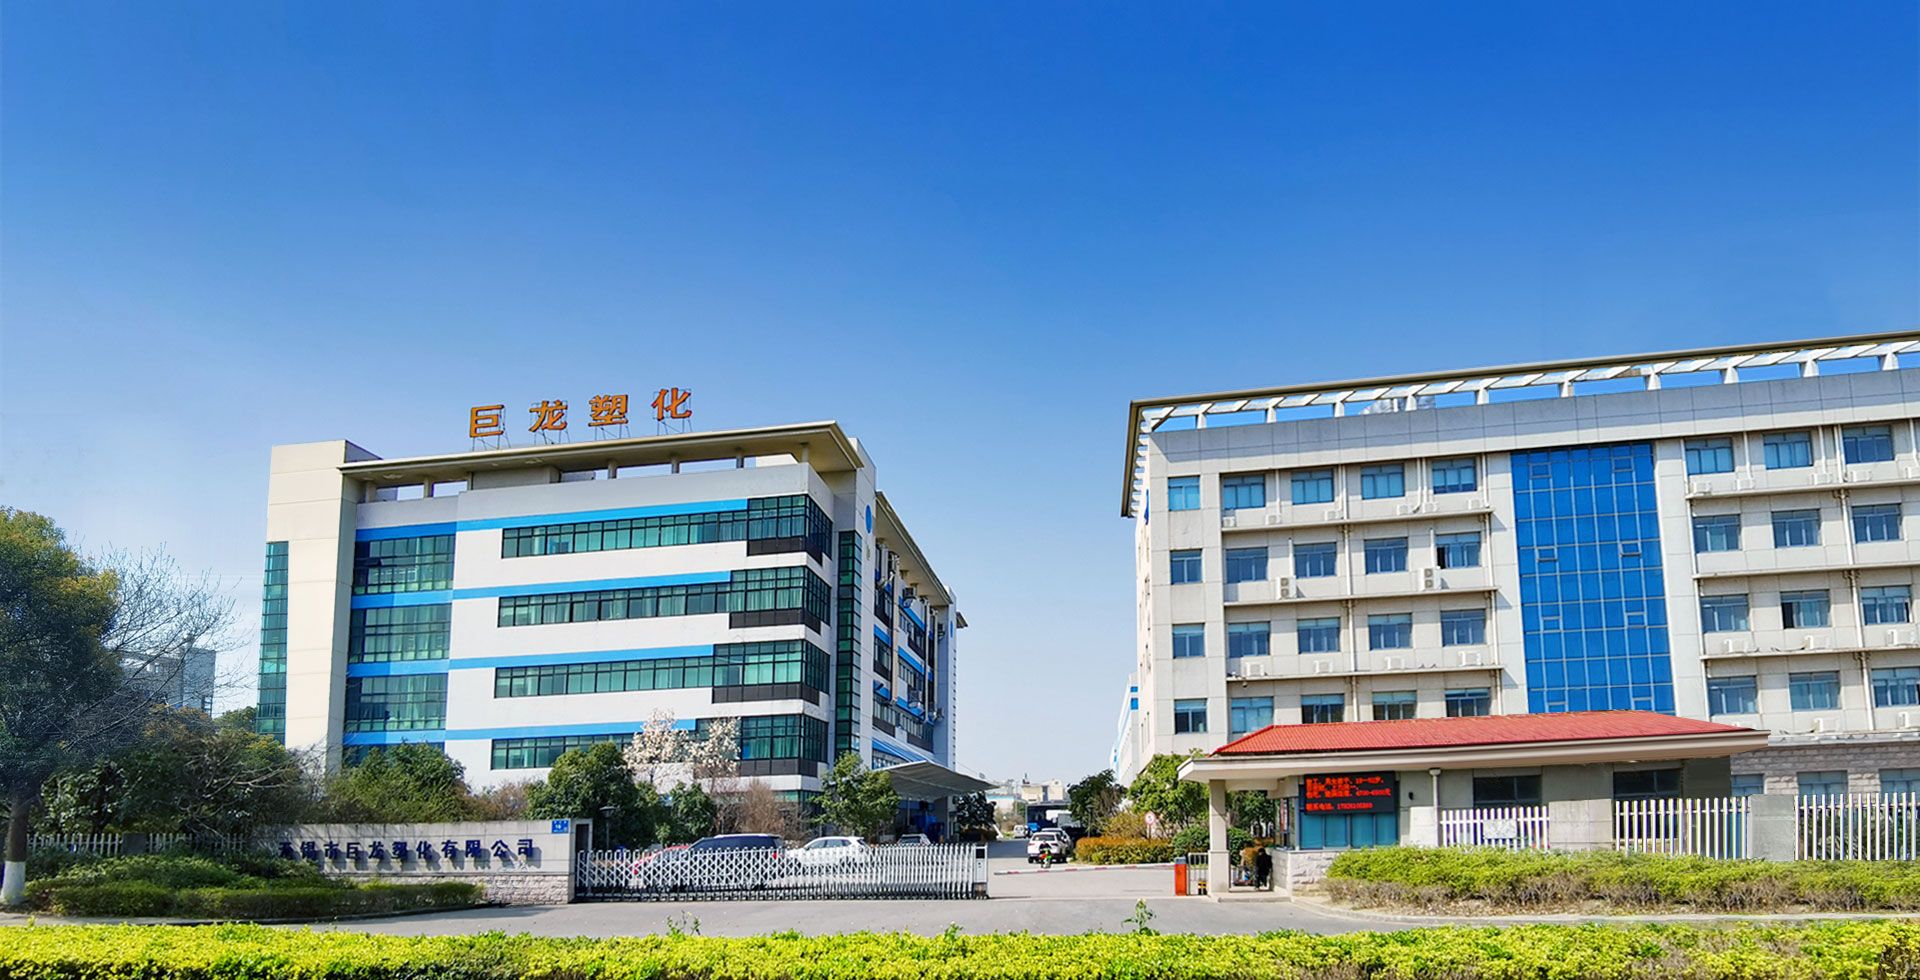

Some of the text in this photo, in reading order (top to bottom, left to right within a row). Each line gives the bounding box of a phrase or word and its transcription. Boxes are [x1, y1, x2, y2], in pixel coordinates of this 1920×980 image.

[469, 387, 692, 438] 巨龙塑化
[279, 839, 533, 860] 无锡市巨龙塑化有限公司
